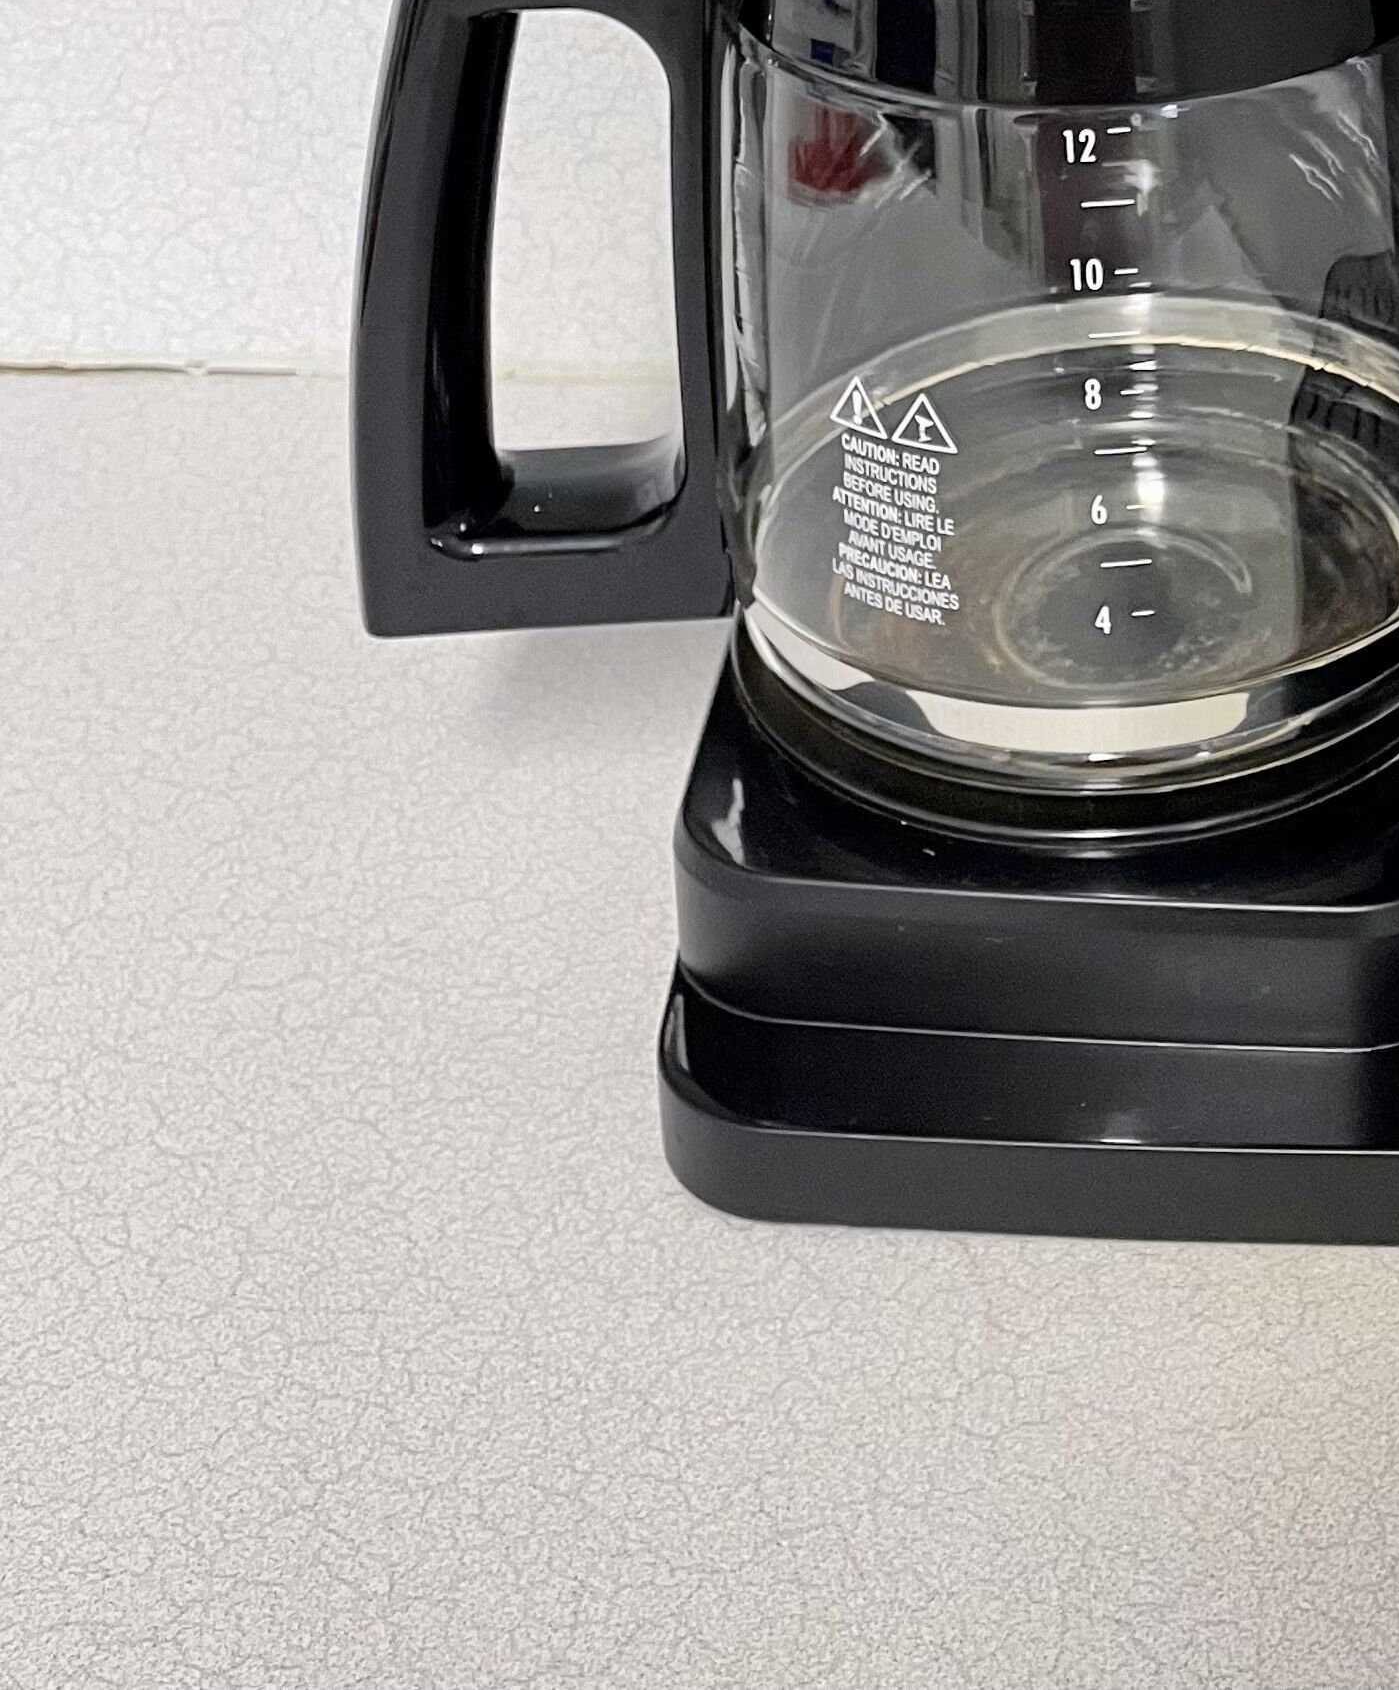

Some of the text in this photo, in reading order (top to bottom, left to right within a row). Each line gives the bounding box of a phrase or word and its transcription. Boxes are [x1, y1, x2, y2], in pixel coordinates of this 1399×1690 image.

[1062, 128, 1097, 164] 12
[1069, 258, 1104, 292] 10
[1083, 377, 1102, 411] 8
[841, 432, 940, 476] CAUTION: READ
[843, 471, 940, 515] BEFORE USING.
[844, 453, 938, 495] INSTRUCTIONS
[832, 485, 956, 536] ATTENTION: LIRE LE
[1090, 494, 1107, 525] 6
[843, 508, 942, 552] MODE D'EMPLOI
[848, 530, 886, 557] AVANT
[832, 557, 960, 611] LAS INSTRUCCIONES
[924, 570, 952, 591] LEA
[844, 581, 946, 626] ANTES DE USAR.
[1094, 605, 1112, 635] 4
